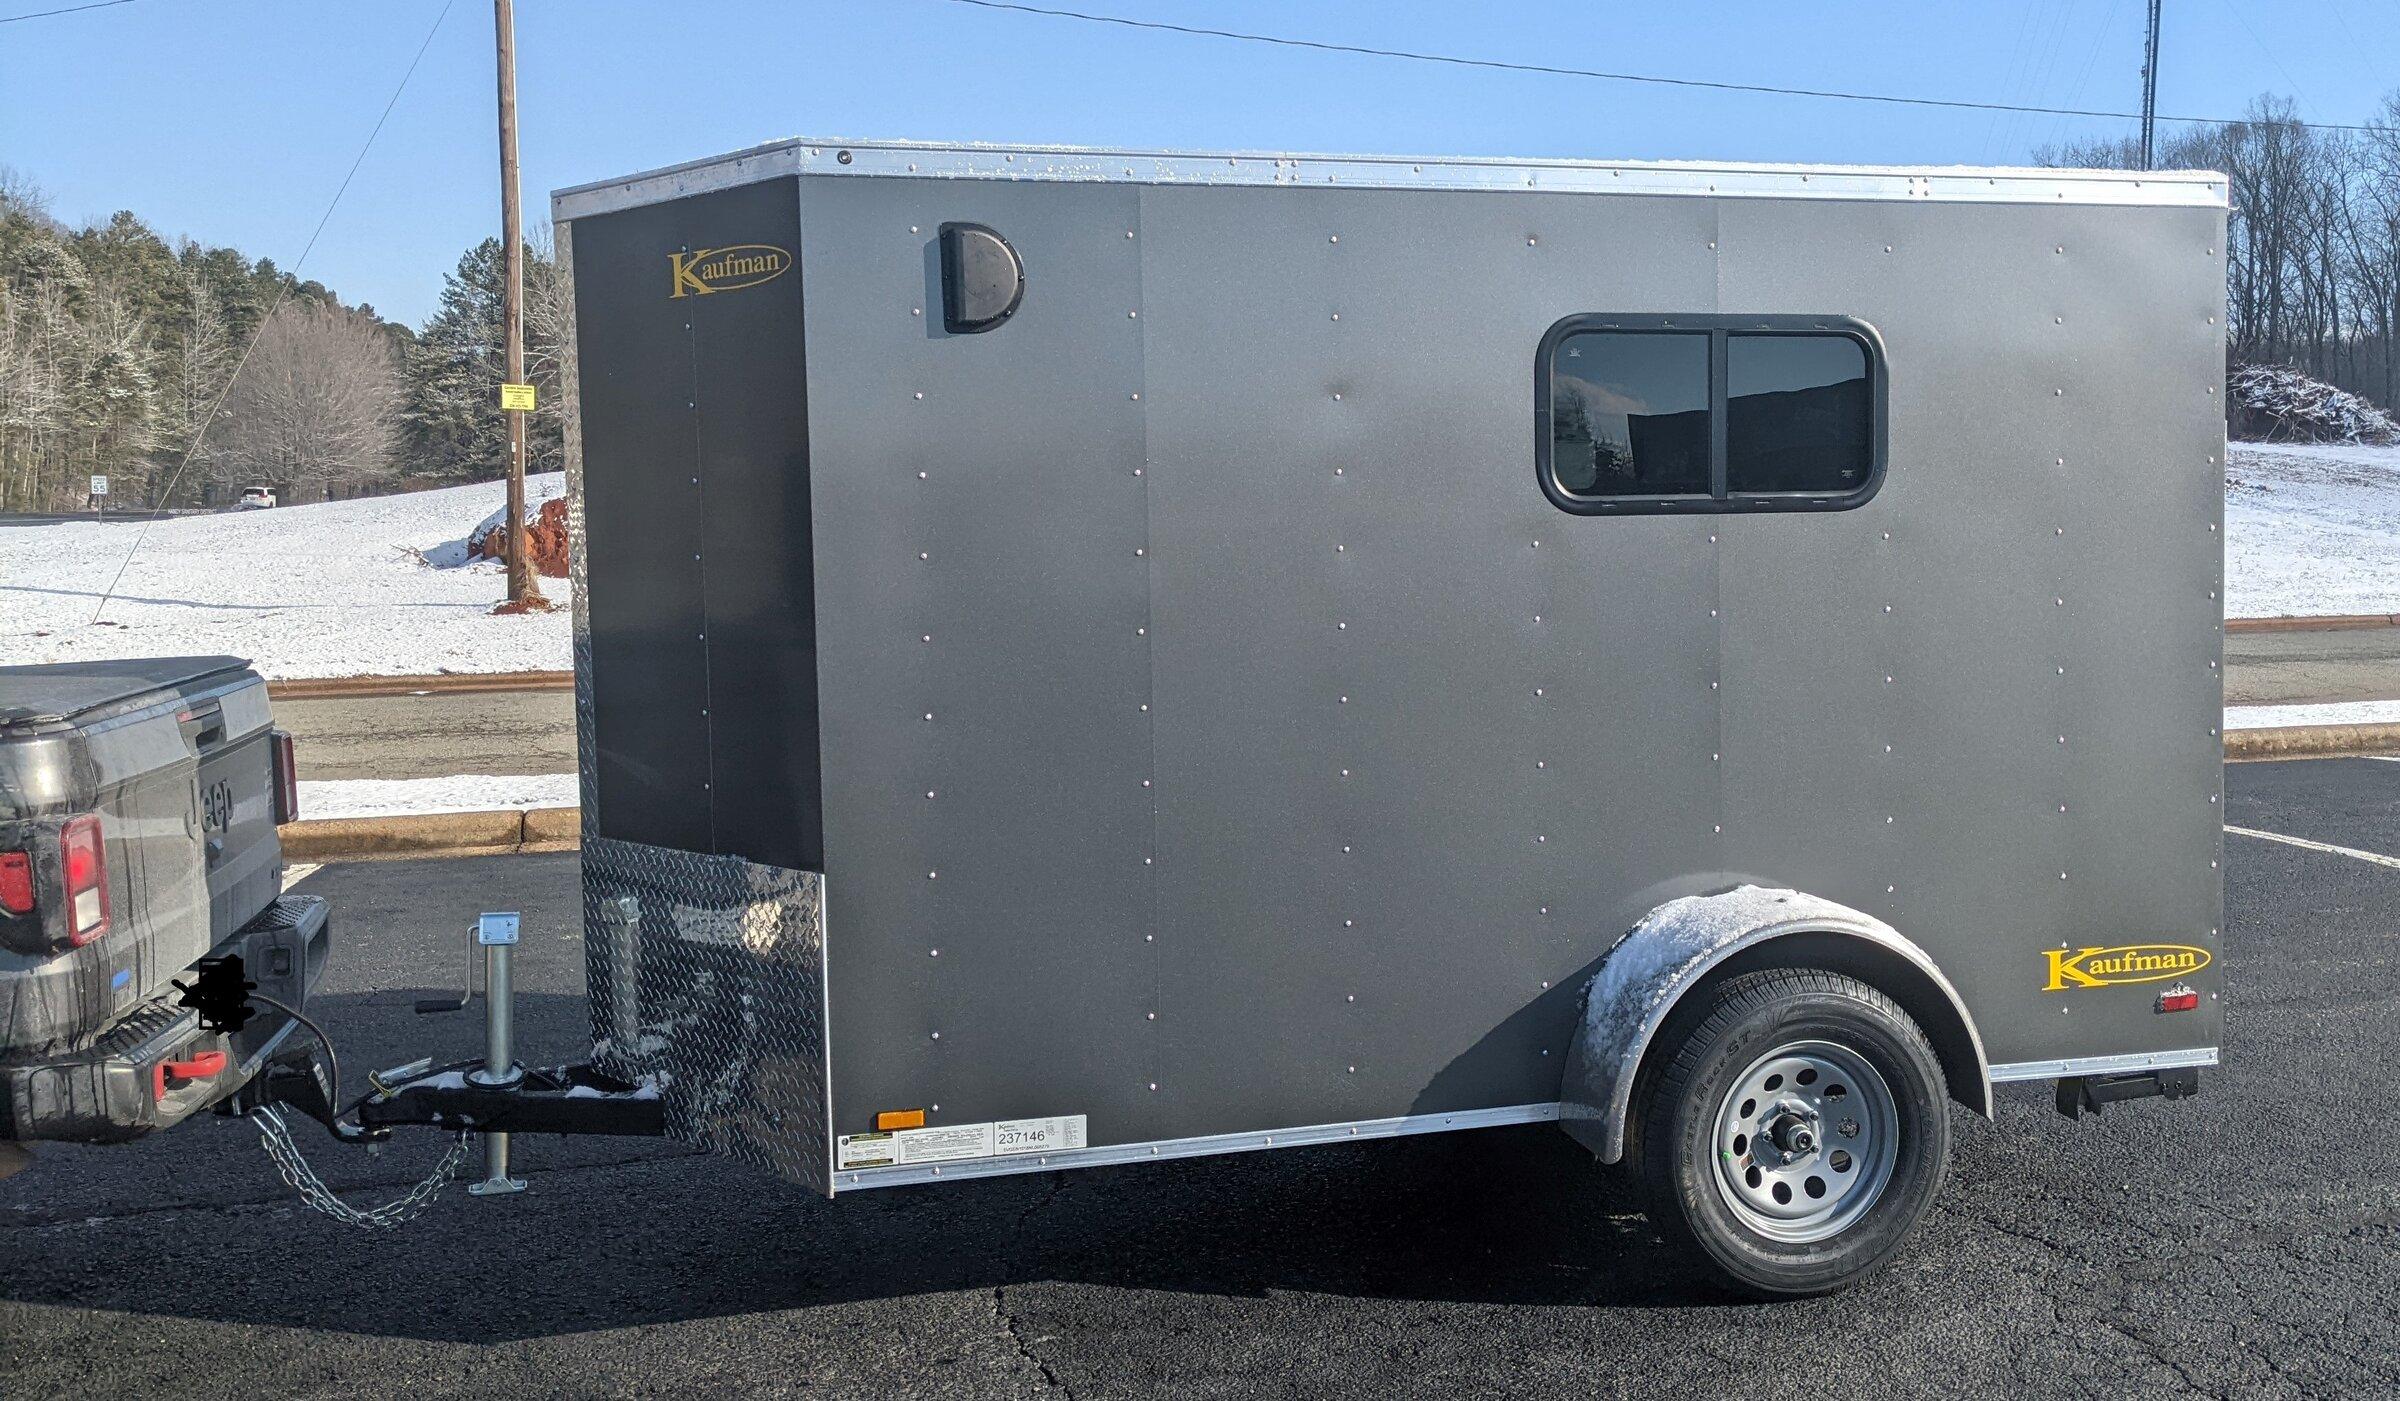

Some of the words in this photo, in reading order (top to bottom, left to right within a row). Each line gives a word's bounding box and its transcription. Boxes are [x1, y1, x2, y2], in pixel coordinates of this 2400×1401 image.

[667, 248, 781, 299] Kaufman
[93, 485, 106, 493] 55
[2041, 946, 2197, 991] Kaufman
[998, 1130, 1046, 1145] 237146
